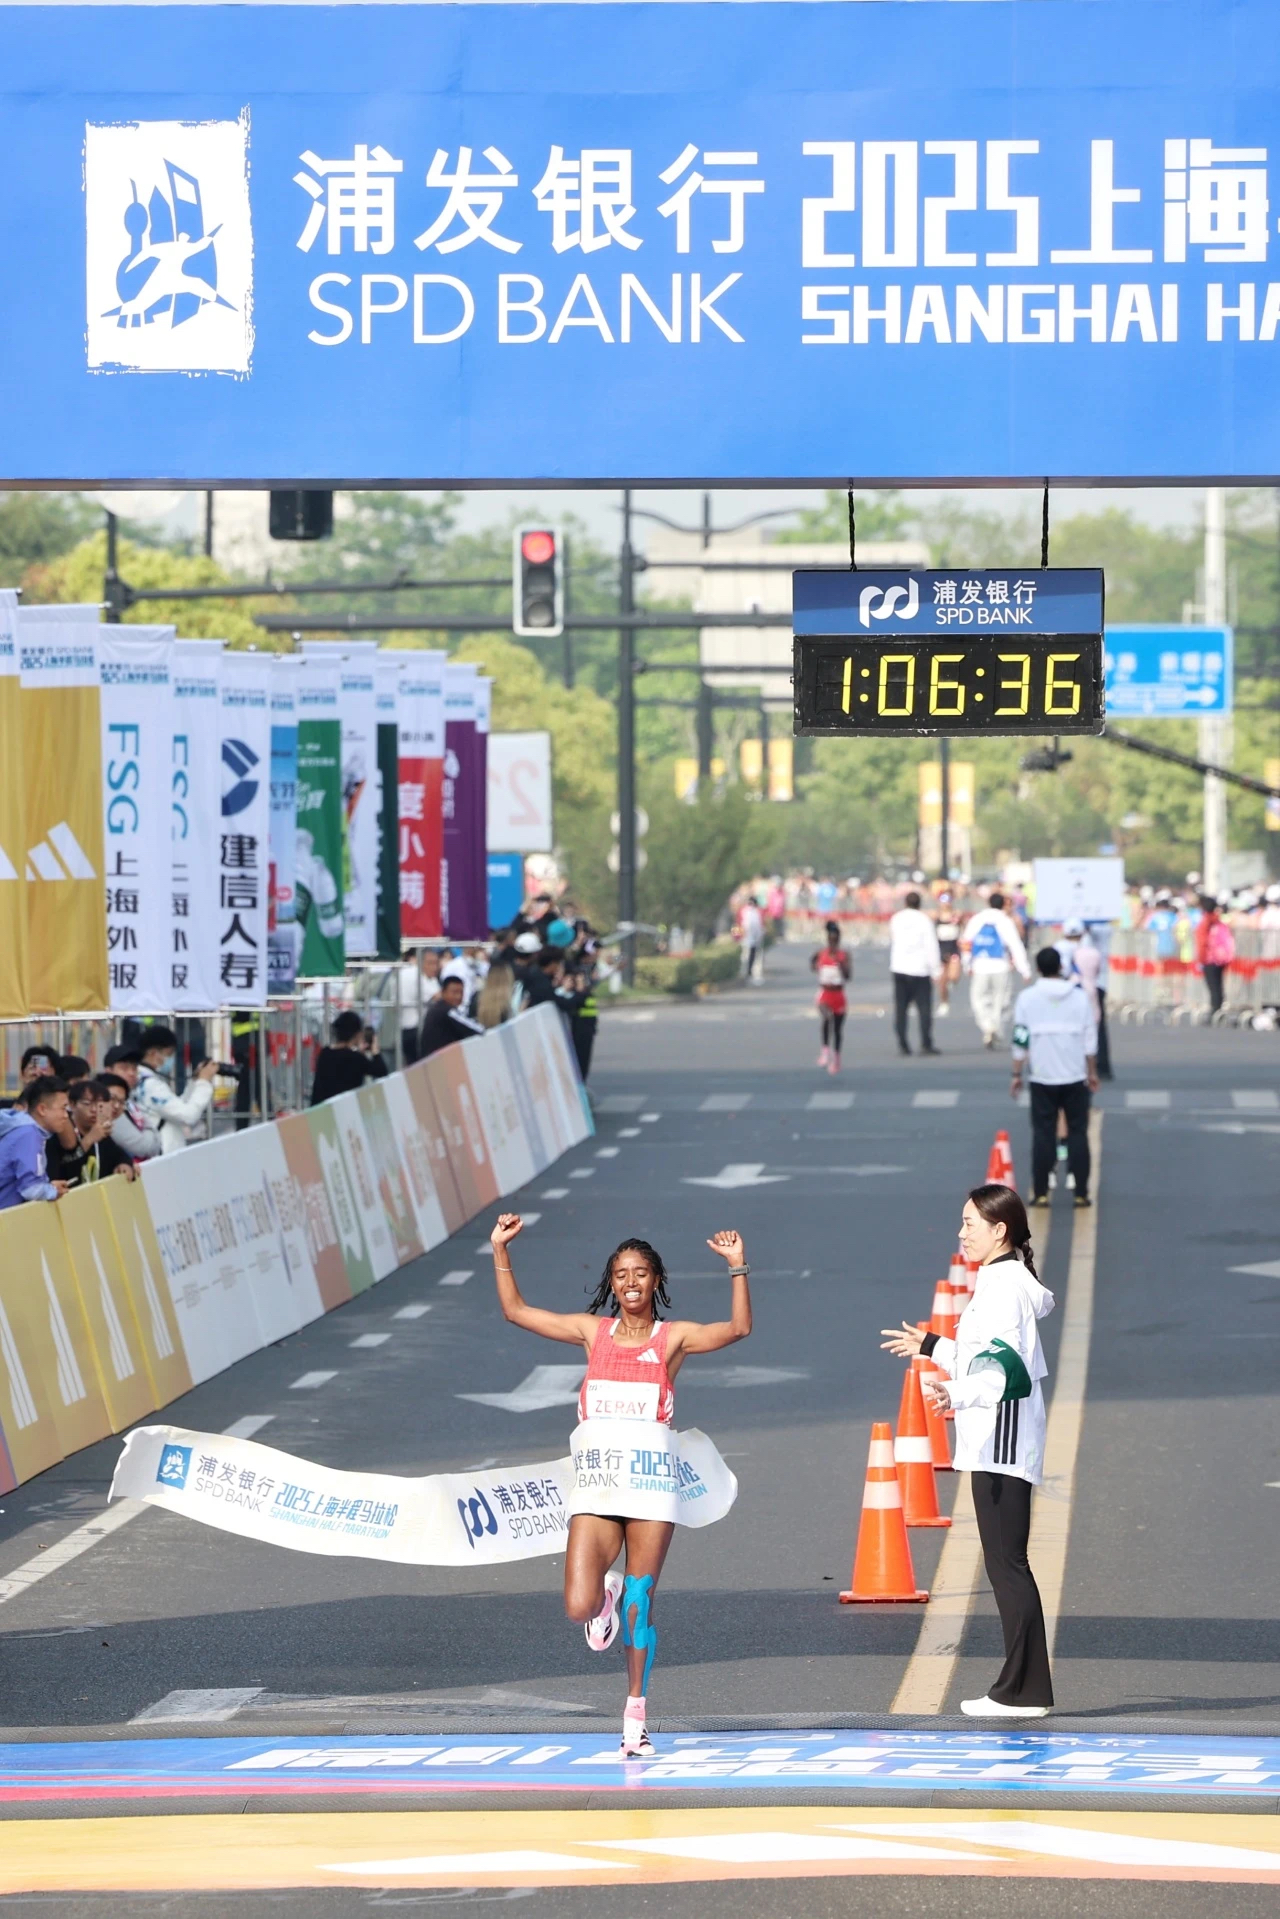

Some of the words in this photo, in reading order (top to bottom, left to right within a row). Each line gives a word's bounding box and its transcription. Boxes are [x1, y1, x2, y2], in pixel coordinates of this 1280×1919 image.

[292, 144, 765, 255] 浦发银行
[802, 138, 1280, 268] 2025上海
[307, 272, 475, 346] SPD
[499, 272, 746, 344] BANK
[801, 283, 1179, 344] SHANGHAI
[932, 579, 1037, 605] 浦发银行
[935, 607, 974, 625] SPD
[977, 607, 1034, 625] BANK
[842, 653, 1081, 717] 1:06:36
[107, 723, 140, 835] FSG
[106, 850, 140, 990] 上海外服
[220, 833, 260, 990] 建信人寿
[595, 1399, 647, 1415] ZERAY
[196, 1454, 276, 1498] 浦发银行
[574, 1448, 624, 1472] 发银行
[578, 1472, 620, 1488] BANK
[193, 1477, 225, 1499] SPD
[224, 1487, 267, 1514] BANK
[491, 1478, 563, 1514] 浦发银行
[268, 1506, 321, 1530] SHANGHAI
[319, 1519, 344, 1532] HALF
[341, 1521, 391, 1540] MARATHON
[508, 1514, 534, 1540] SPD
[531, 1509, 568, 1535] BANK
